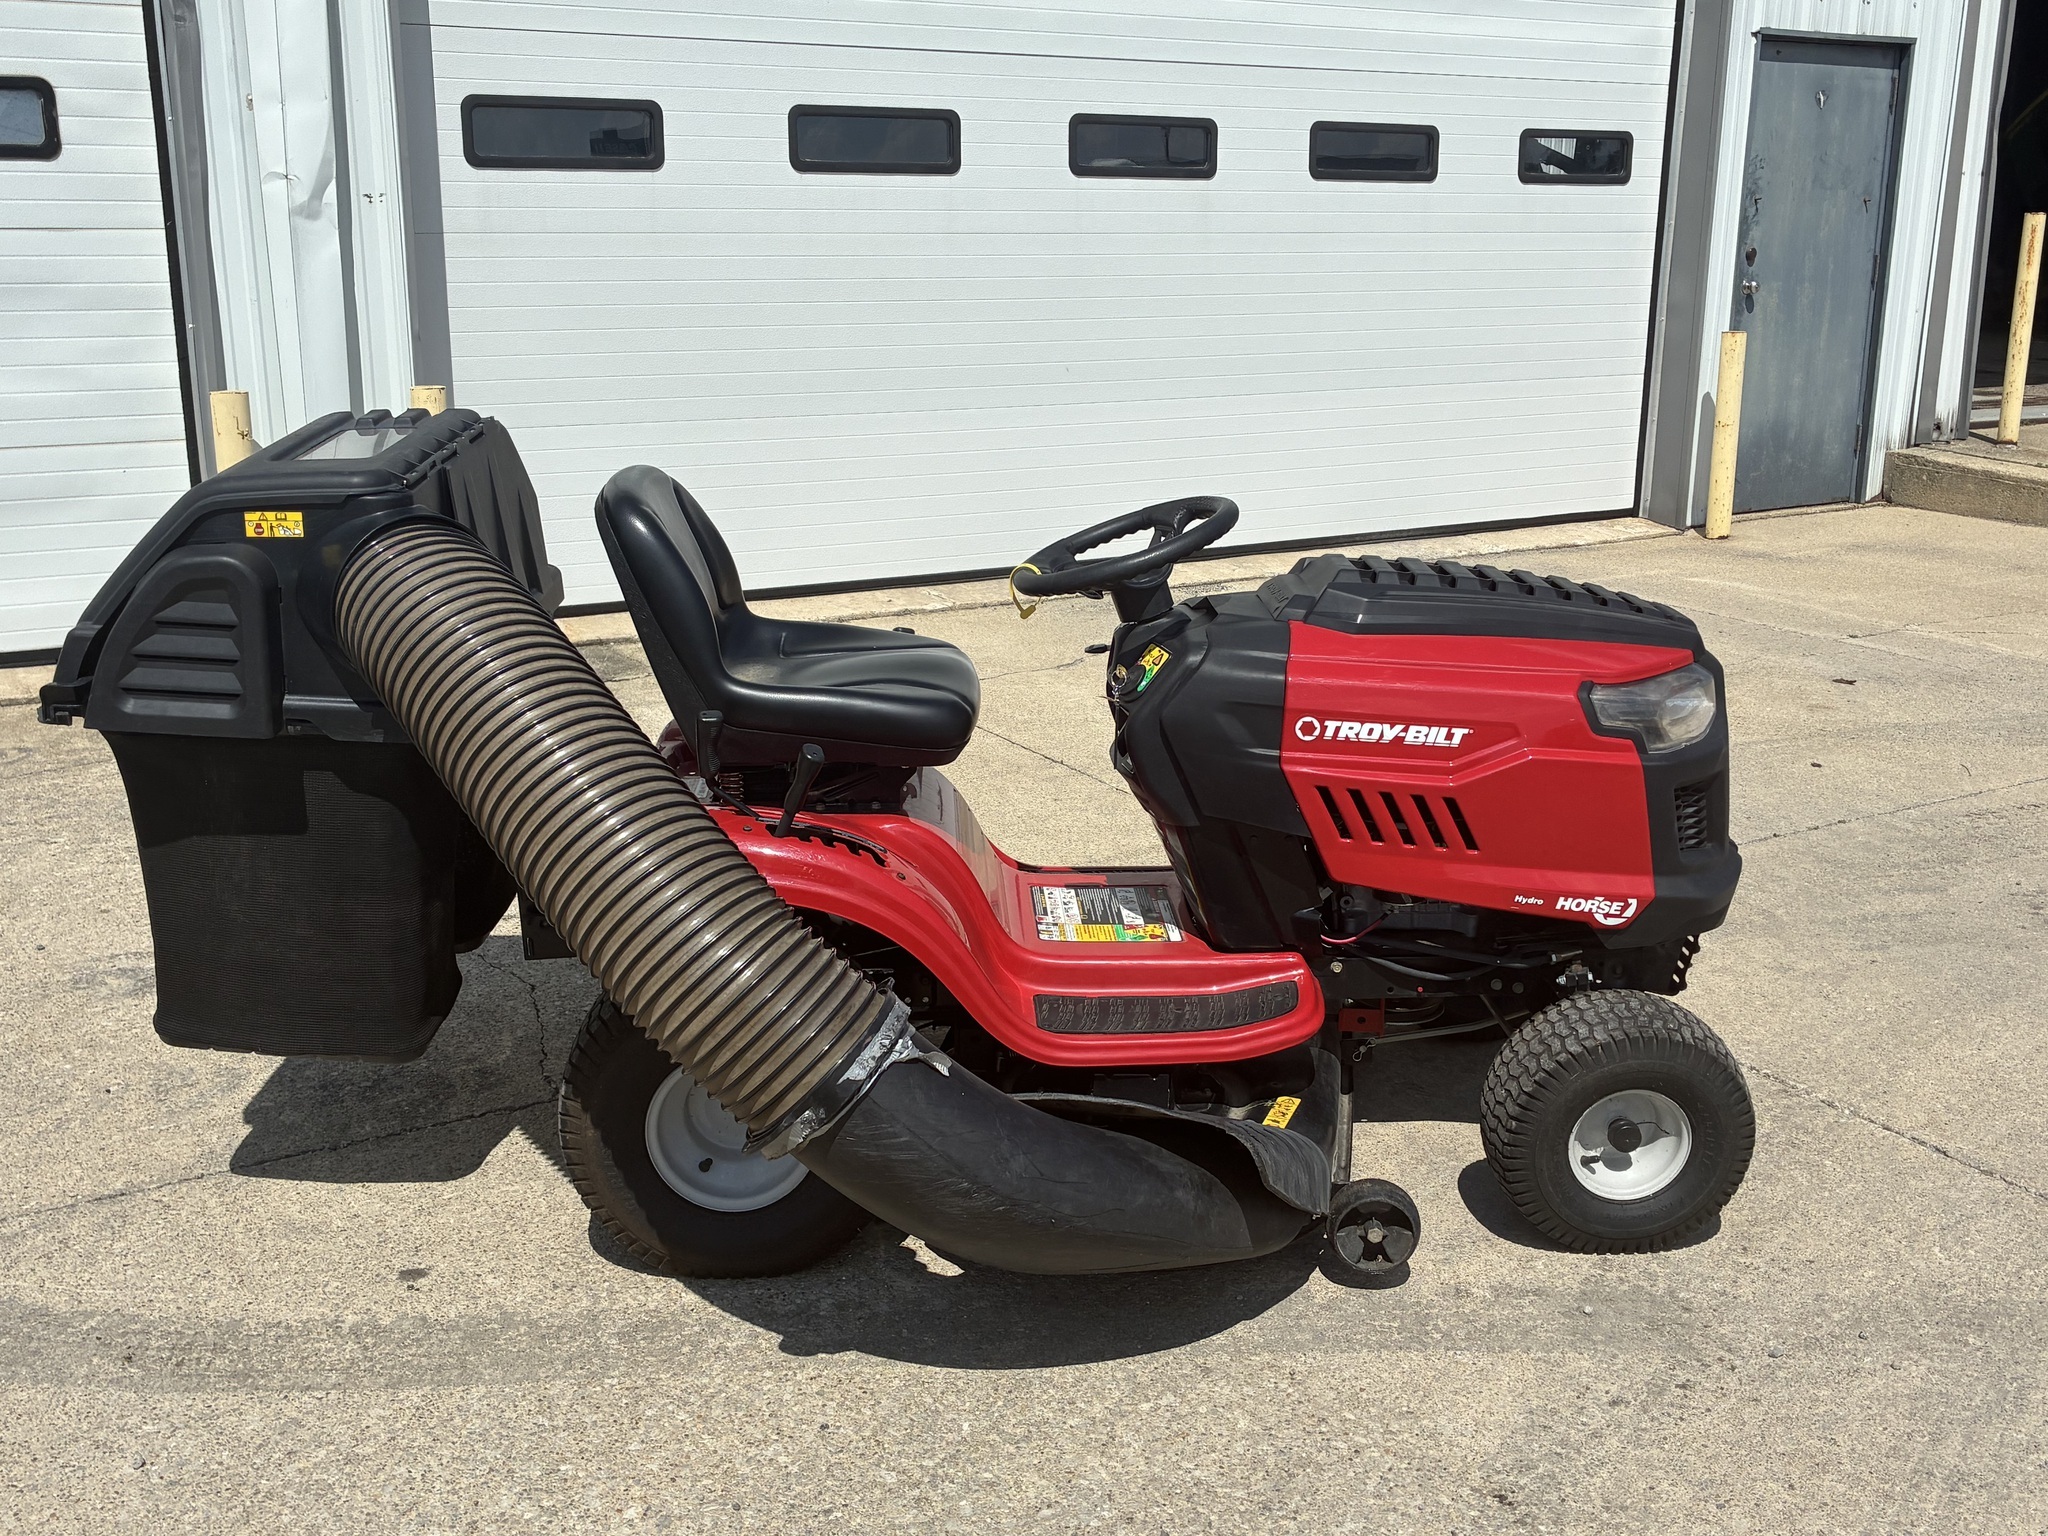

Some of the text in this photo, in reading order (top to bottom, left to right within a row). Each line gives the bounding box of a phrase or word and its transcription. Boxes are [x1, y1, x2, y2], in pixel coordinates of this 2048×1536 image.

[1323, 719, 1470, 748] TROY-BILT
[1514, 895, 1625, 915] Hydro HORSE
